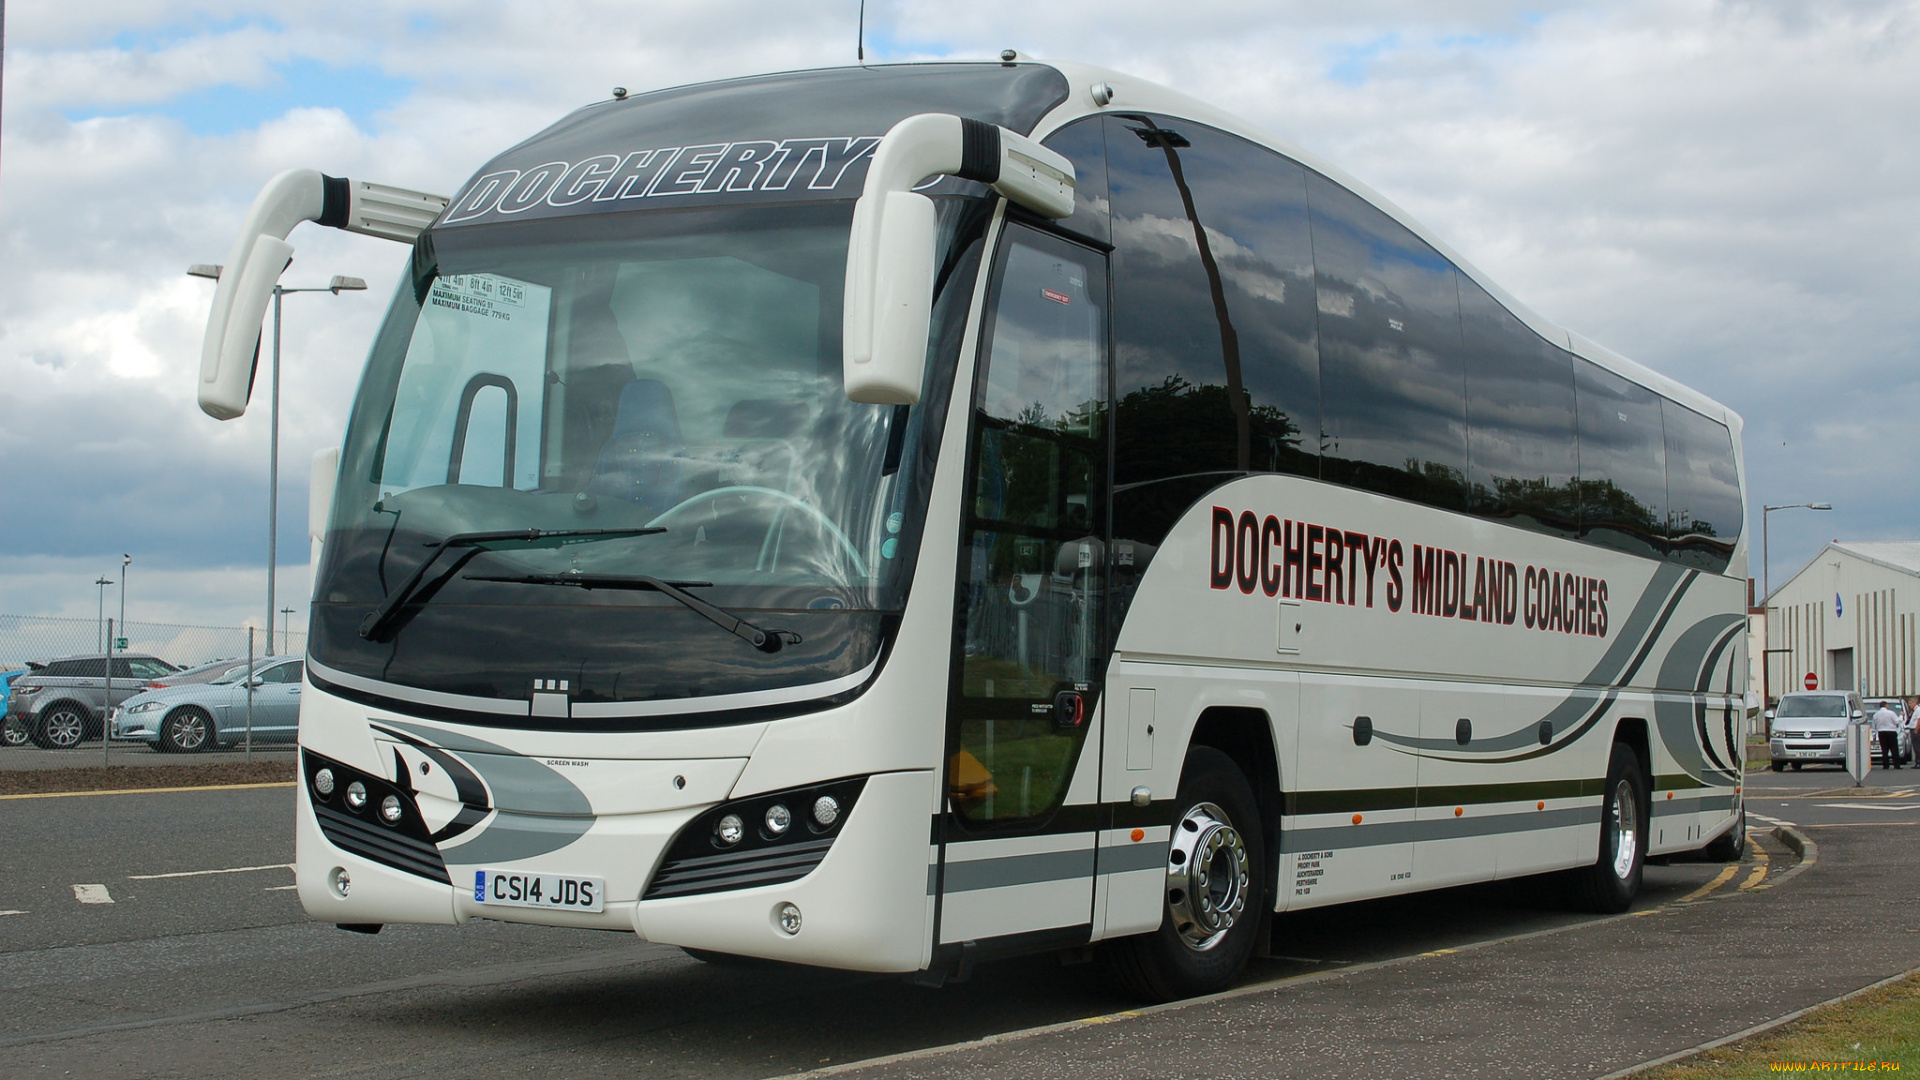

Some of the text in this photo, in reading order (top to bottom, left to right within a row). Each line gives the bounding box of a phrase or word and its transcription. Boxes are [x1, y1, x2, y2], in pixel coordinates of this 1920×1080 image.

[443, 136, 945, 224] DOCHERTY
[470, 278, 480, 290] 8ft
[482, 280, 493, 293] 4in
[499, 284, 512, 298] 12ft
[512, 288, 523, 300] 5in
[432, 298, 460, 310] MAXIMUM
[461, 304, 489, 317] BAGGAGE
[433, 289, 461, 302] MAXIMUM
[462, 296, 487, 308] SEATING
[1210, 505, 1609, 639] DOCHERTY'S MIDLAND COACHES
[494, 875, 594, 907] CS14 JDS
